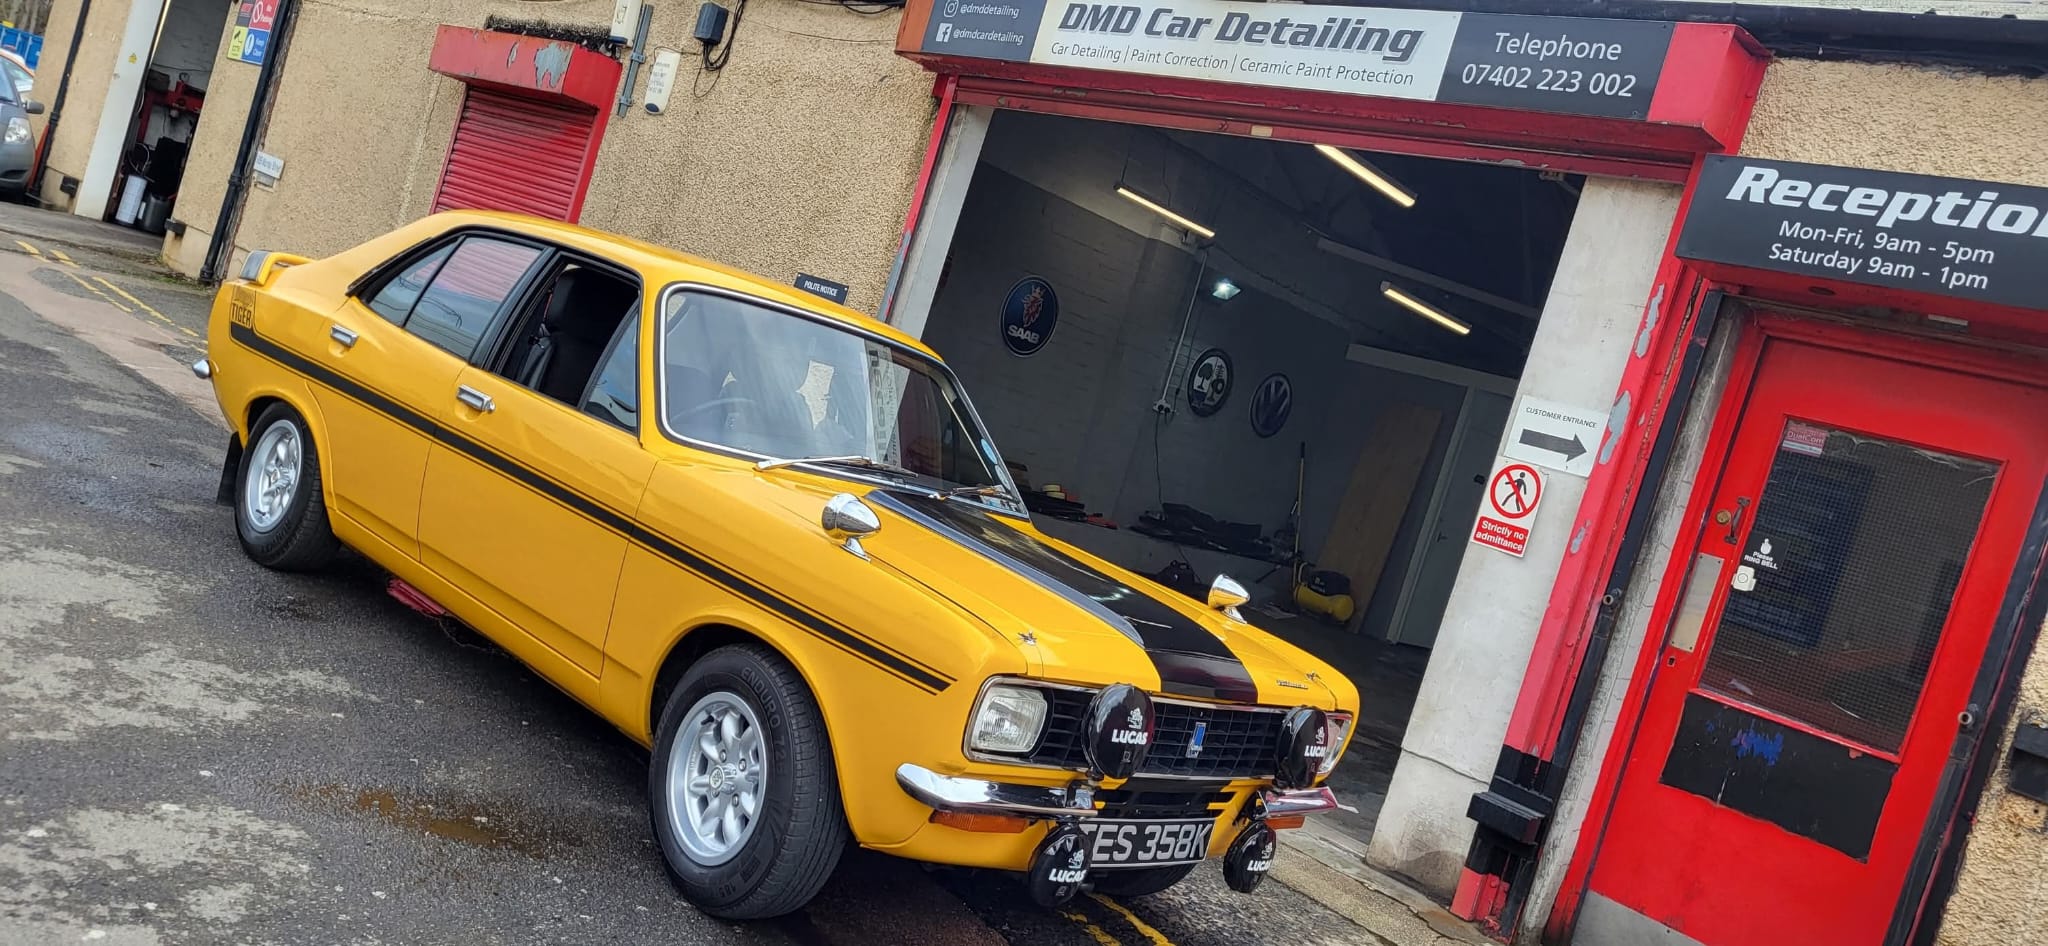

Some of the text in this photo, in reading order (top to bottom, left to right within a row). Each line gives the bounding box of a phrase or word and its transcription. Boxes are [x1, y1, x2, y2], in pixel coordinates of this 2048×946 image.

[959, 2, 1020, 19] @dmddetailing
[952, 28, 1024, 46] @dmdcardetailing
[1058, 3, 1425, 62] DMD Car Detailing
[1494, 32, 1622, 61] Telephone
[1051, 42, 1073, 56] Car
[1077, 43, 1122, 62] Detailing
[1131, 50, 1162, 65] Paint
[1164, 51, 1228, 71] Correction
[1240, 57, 1294, 76] Ceramic
[1296, 62, 1332, 80] Paint
[1336, 65, 1415, 86] Protection
[1462, 64, 1636, 97] 07402 223 002
[1778, 220, 1867, 251] Mon-Fri,
[1873, 232, 1921, 255] 9am
[1942, 241, 1996, 265] 5pm
[1769, 243, 1863, 276] Saturday
[1867, 256, 1915, 279] 9am
[1939, 266, 1990, 291] 1pm
[803, 280, 838, 297] POLITE NOTICE
[231, 302, 252, 328] TIGER
[1008, 324, 1040, 344] SAAB
[1526, 407, 1597, 429] CUSTOMER ENTRANCE
[1481, 520, 1525, 540] Strictly no
[1475, 531, 1523, 551] admittance
[1744, 554, 1778, 570] RING BELL
[1752, 551, 1774, 562] Please
[741, 666, 783, 729] ENDURO
[1111, 728, 1149, 745] LUCAS
[1137, 823, 1213, 861] 358K
[1048, 868, 1087, 883] LUCAS
